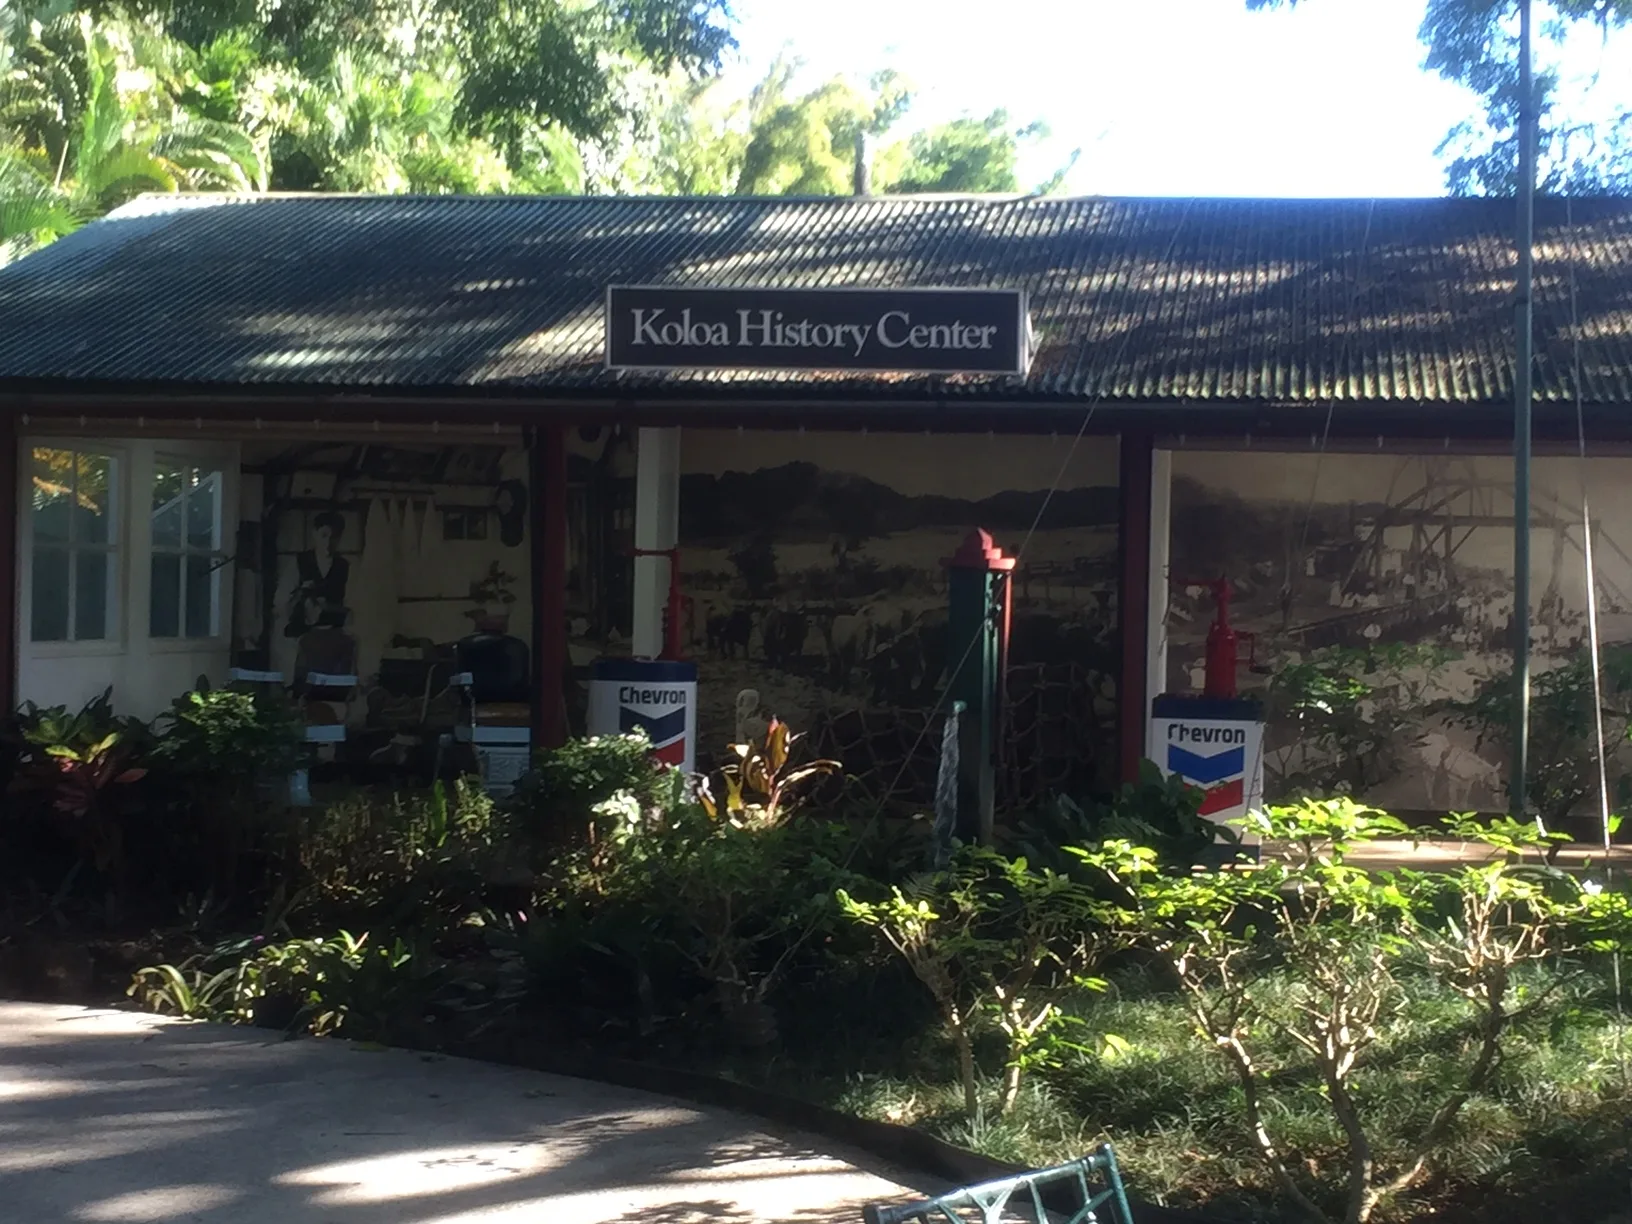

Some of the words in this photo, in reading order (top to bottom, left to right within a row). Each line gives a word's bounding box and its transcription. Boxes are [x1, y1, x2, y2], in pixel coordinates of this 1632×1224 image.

[631, 308, 731, 346] Koloa
[736, 309, 872, 357] History
[876, 311, 998, 349] Center
[619, 686, 686, 704] Chevron
